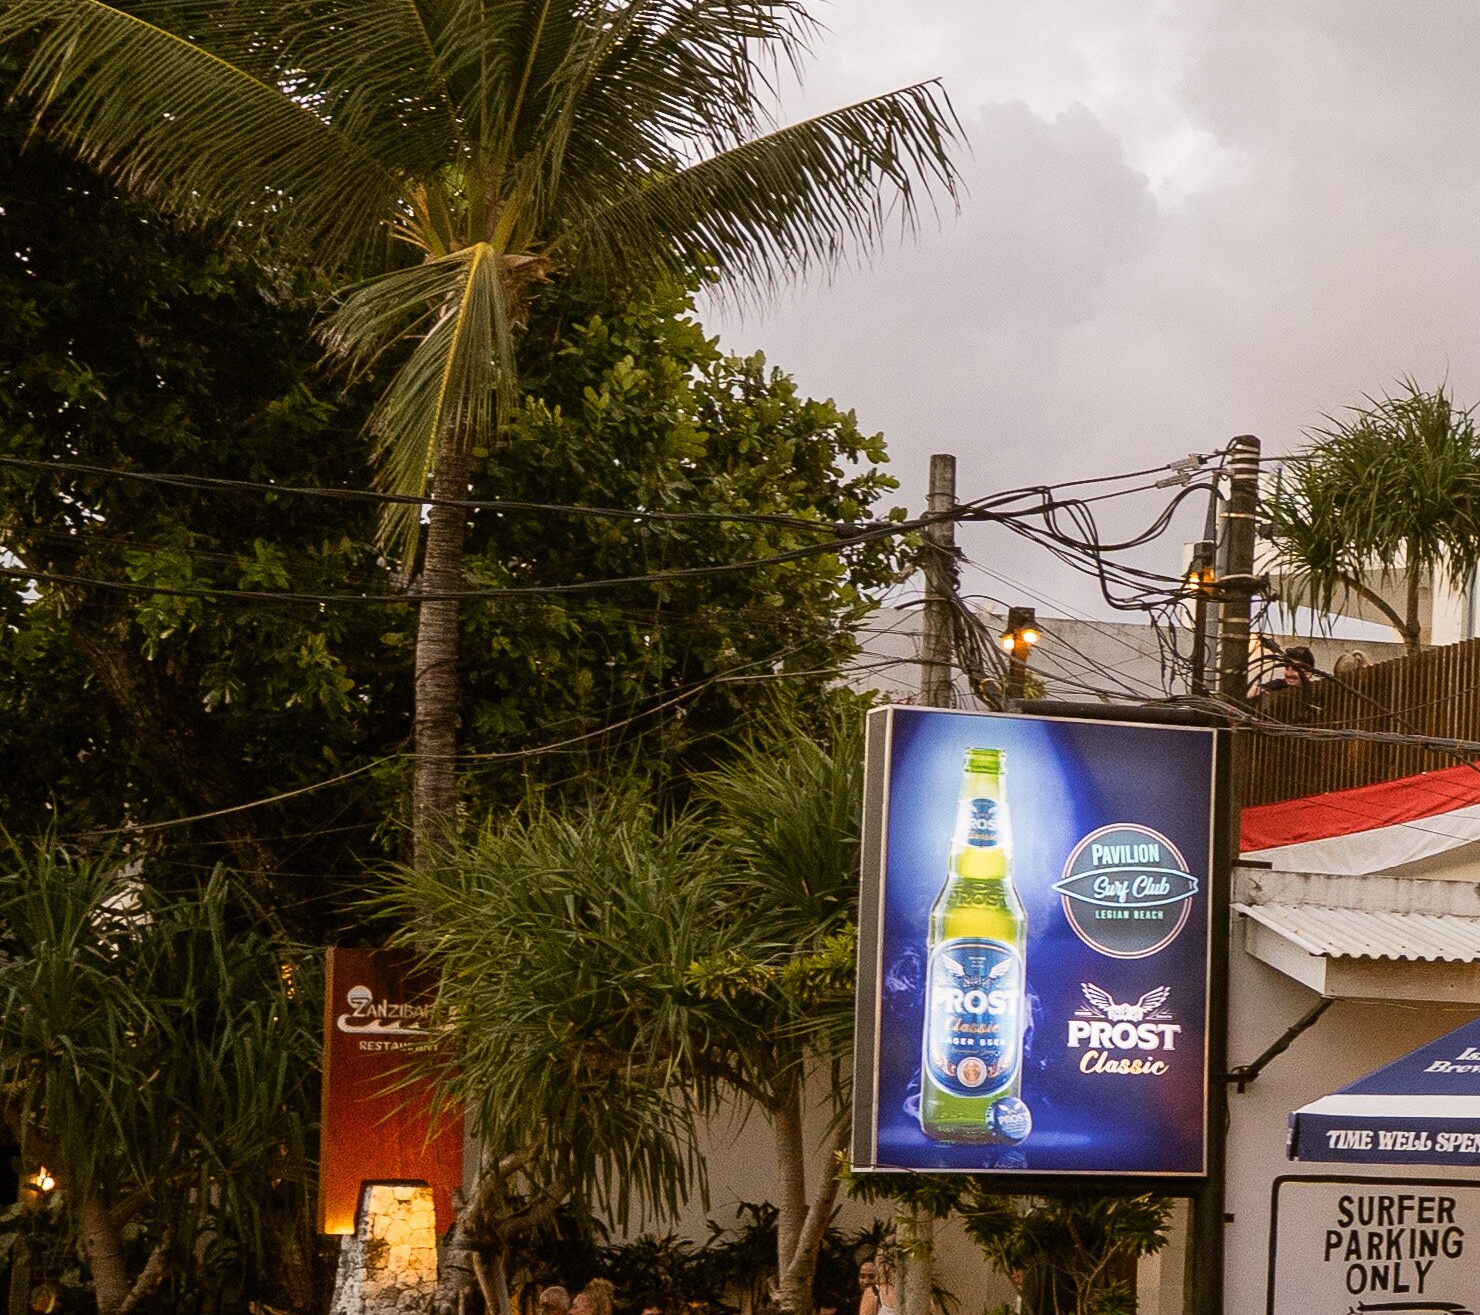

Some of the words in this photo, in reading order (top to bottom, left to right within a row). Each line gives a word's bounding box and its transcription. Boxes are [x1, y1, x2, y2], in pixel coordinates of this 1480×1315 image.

[1092, 843, 1161, 866] PAVILION
[1093, 876, 1129, 903] Surf
[1132, 874, 1171, 897] Club
[1095, 909, 1130, 920] LEGIAN
[1133, 910, 1164, 921] BEACH
[932, 988, 1020, 1016] PROST
[1066, 1020, 1182, 1051] PROST
[1079, 1048, 1170, 1078] Classic
[1326, 1129, 1374, 1151] TIME
[1377, 1130, 1433, 1153] WELL
[1337, 1194, 1456, 1229] SURFER
[1323, 1226, 1466, 1262] PARKING
[1346, 1260, 1434, 1295] ONLY
